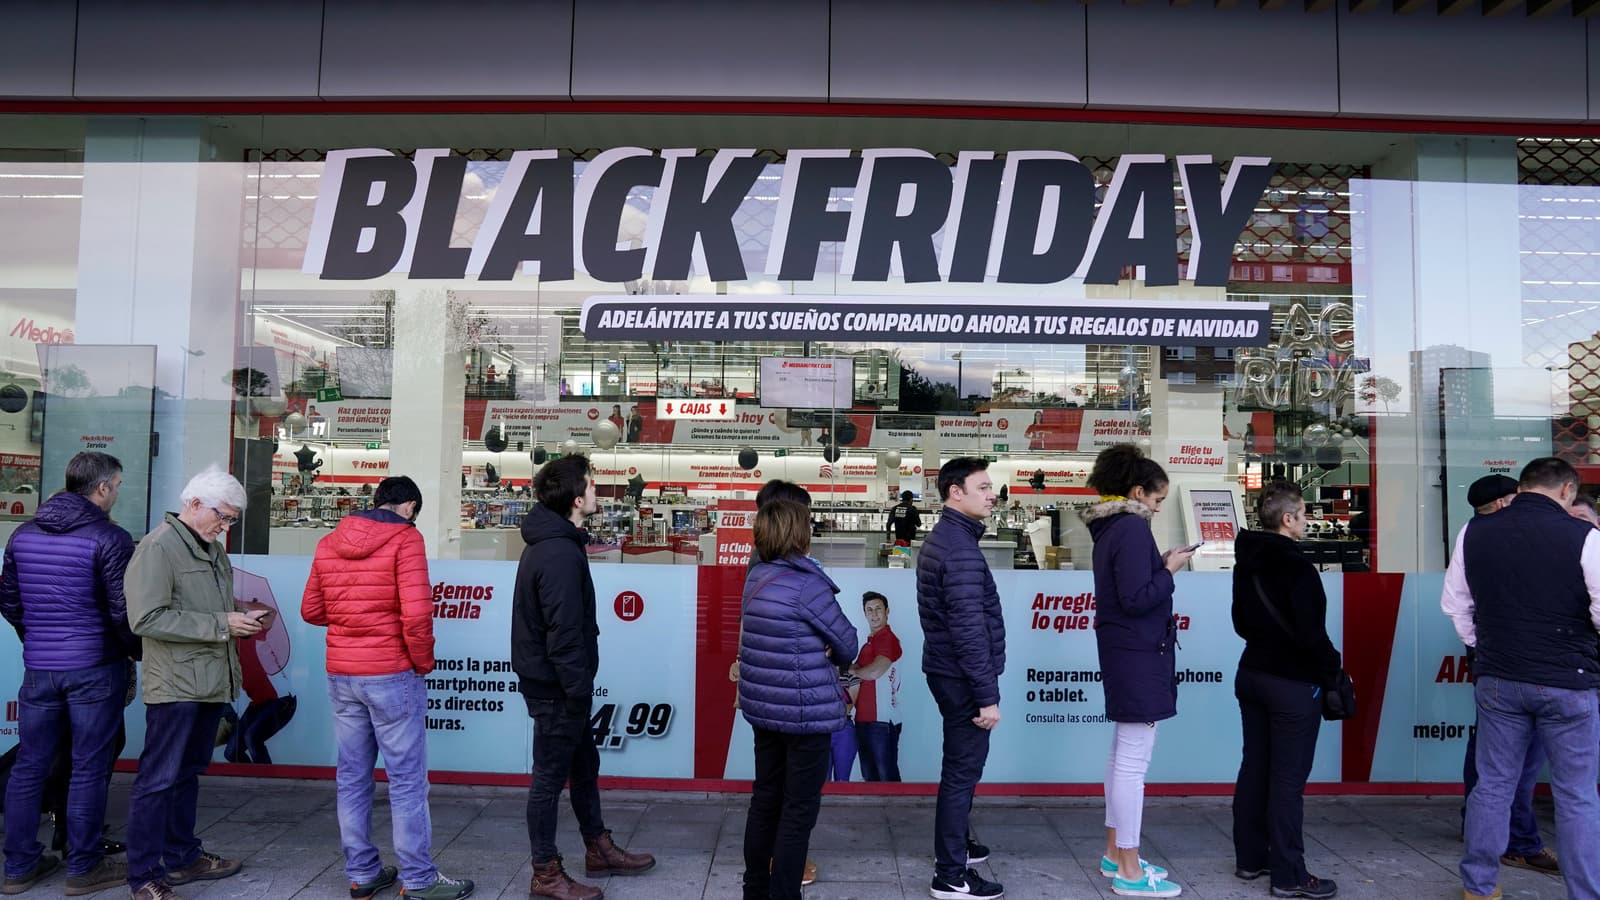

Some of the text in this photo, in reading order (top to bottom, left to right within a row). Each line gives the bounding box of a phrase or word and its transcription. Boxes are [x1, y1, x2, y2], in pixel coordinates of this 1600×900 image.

[319, 156, 1277, 287] BLACK FRIDAY
[598, 307, 1259, 339] ADELÁNTATE A TUS SUEÑOS COMPRANDO AHORA TUS REGALOS DE NAVIDAD
[352, 408, 366, 418] que
[367, 408, 379, 416] tus
[679, 403, 712, 415] CAJAS
[741, 412, 764, 426] hoy
[940, 419, 953, 428] que
[955, 419, 963, 427] te
[1118, 419, 1126, 427] el
[1093, 427, 1123, 437] partido
[1180, 445, 1213, 455] Elige tu
[360, 461, 378, 469] Free
[1168, 455, 1224, 467] servicio aquí
[721, 516, 746, 527] CLUB
[719, 542, 752, 553] El Club
[719, 554, 729, 564] te
[729, 554, 739, 564] lo
[431, 581, 494, 602] gemos
[1031, 612, 1050, 630] lo
[1053, 614, 1089, 633] que
[467, 657, 480, 671] la
[1026, 688, 1088, 703] o tablet.
[445, 696, 504, 712] directos
[1026, 713, 1065, 723] Consulta
[1067, 713, 1085, 723] las
[1413, 722, 1465, 741] mejor
